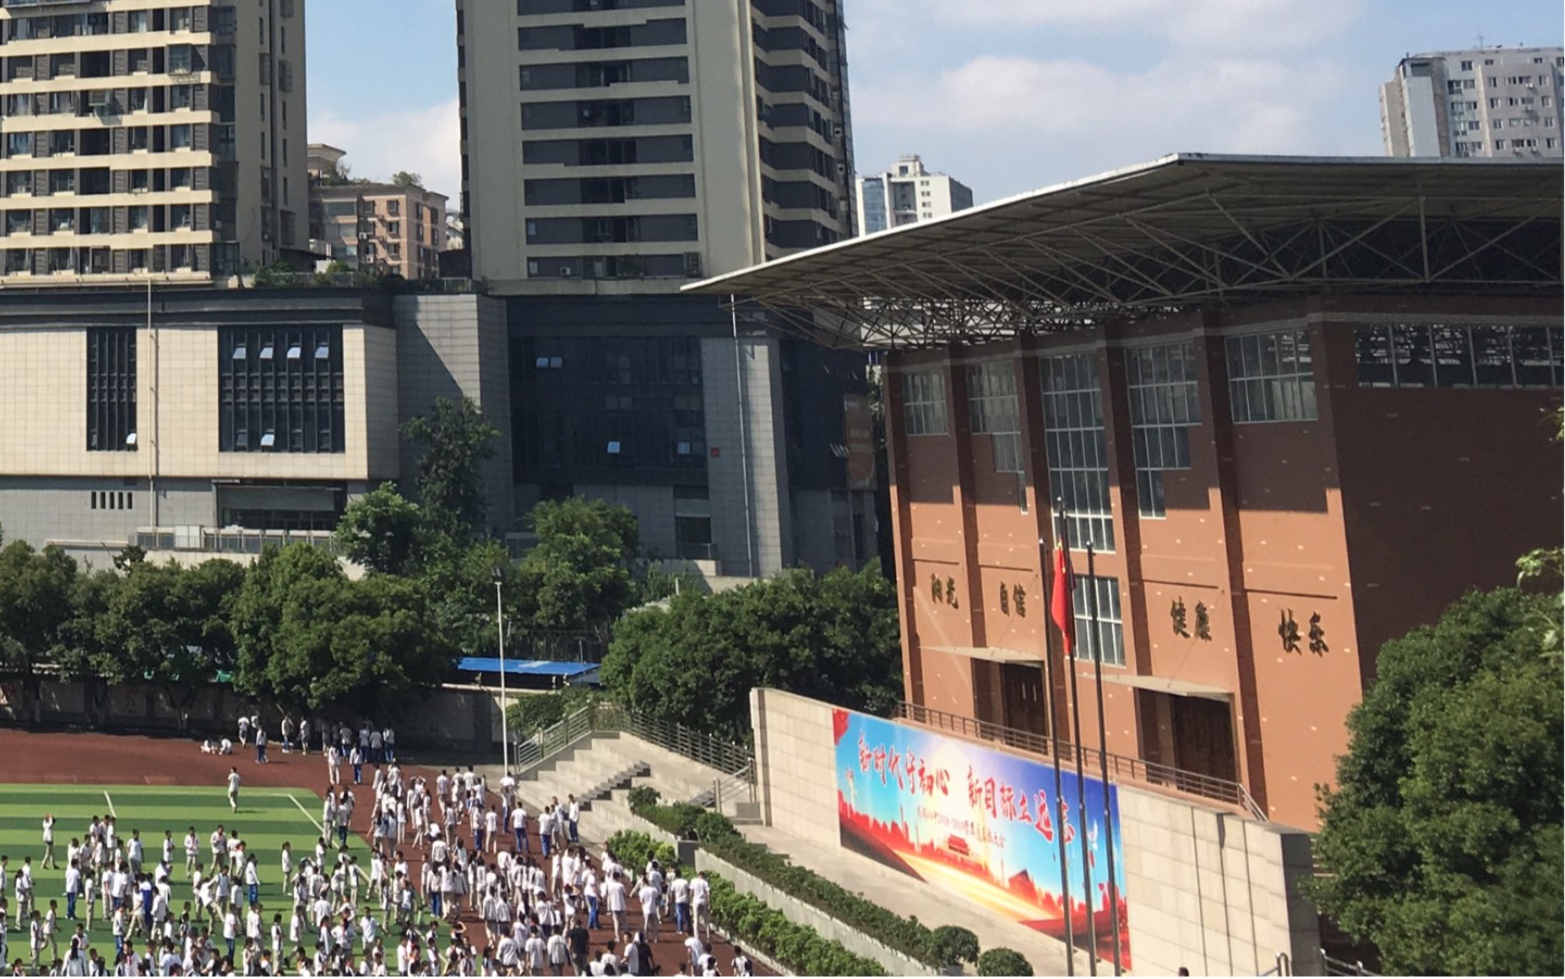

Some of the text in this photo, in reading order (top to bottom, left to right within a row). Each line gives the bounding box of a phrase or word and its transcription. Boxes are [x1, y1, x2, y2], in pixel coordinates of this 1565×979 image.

[930, 573, 959, 610] 阳光
[1000, 581, 1026, 618] 自信
[1169, 596, 1212, 642] 健康
[1278, 608, 1329, 658] 快乐
